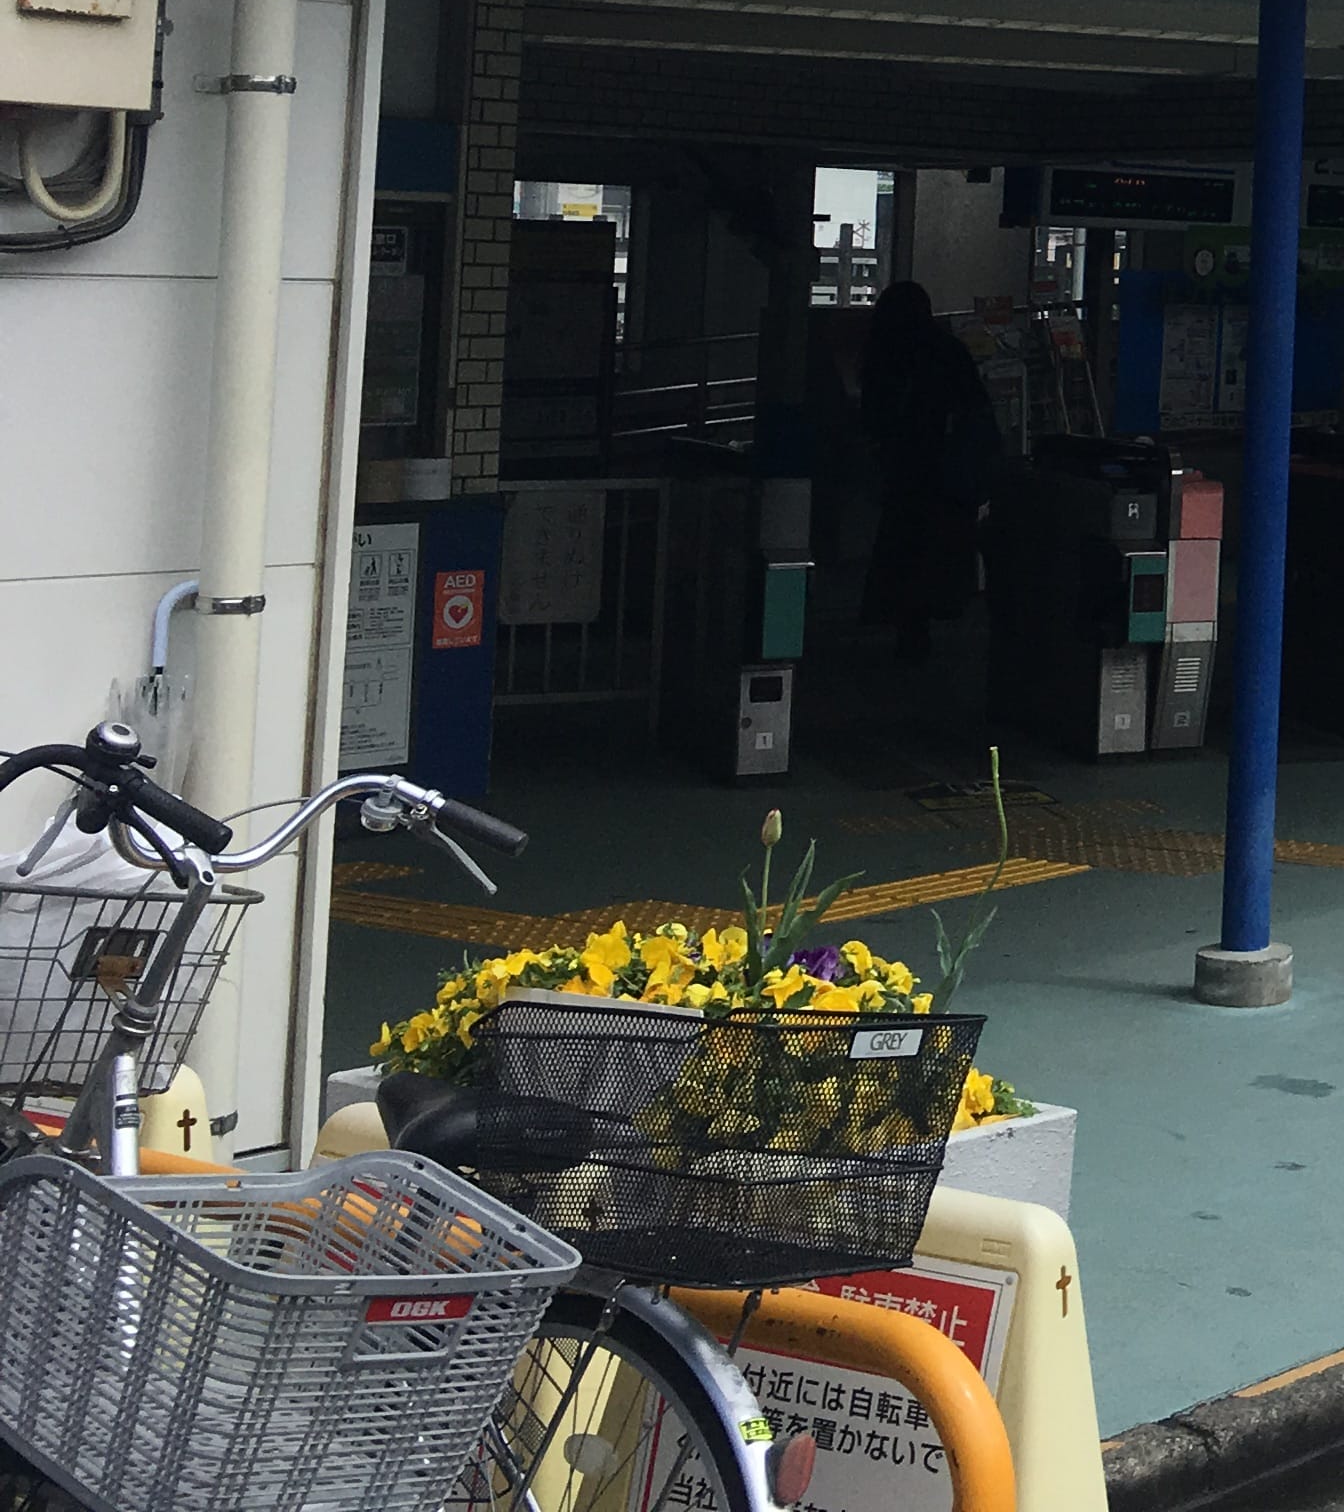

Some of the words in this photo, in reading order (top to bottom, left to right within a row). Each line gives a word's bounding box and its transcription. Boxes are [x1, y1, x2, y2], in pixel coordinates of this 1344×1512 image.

[444, 574, 476, 589] AED
[870, 1032, 908, 1050] GREY
[390, 1300, 450, 1317] OGK
